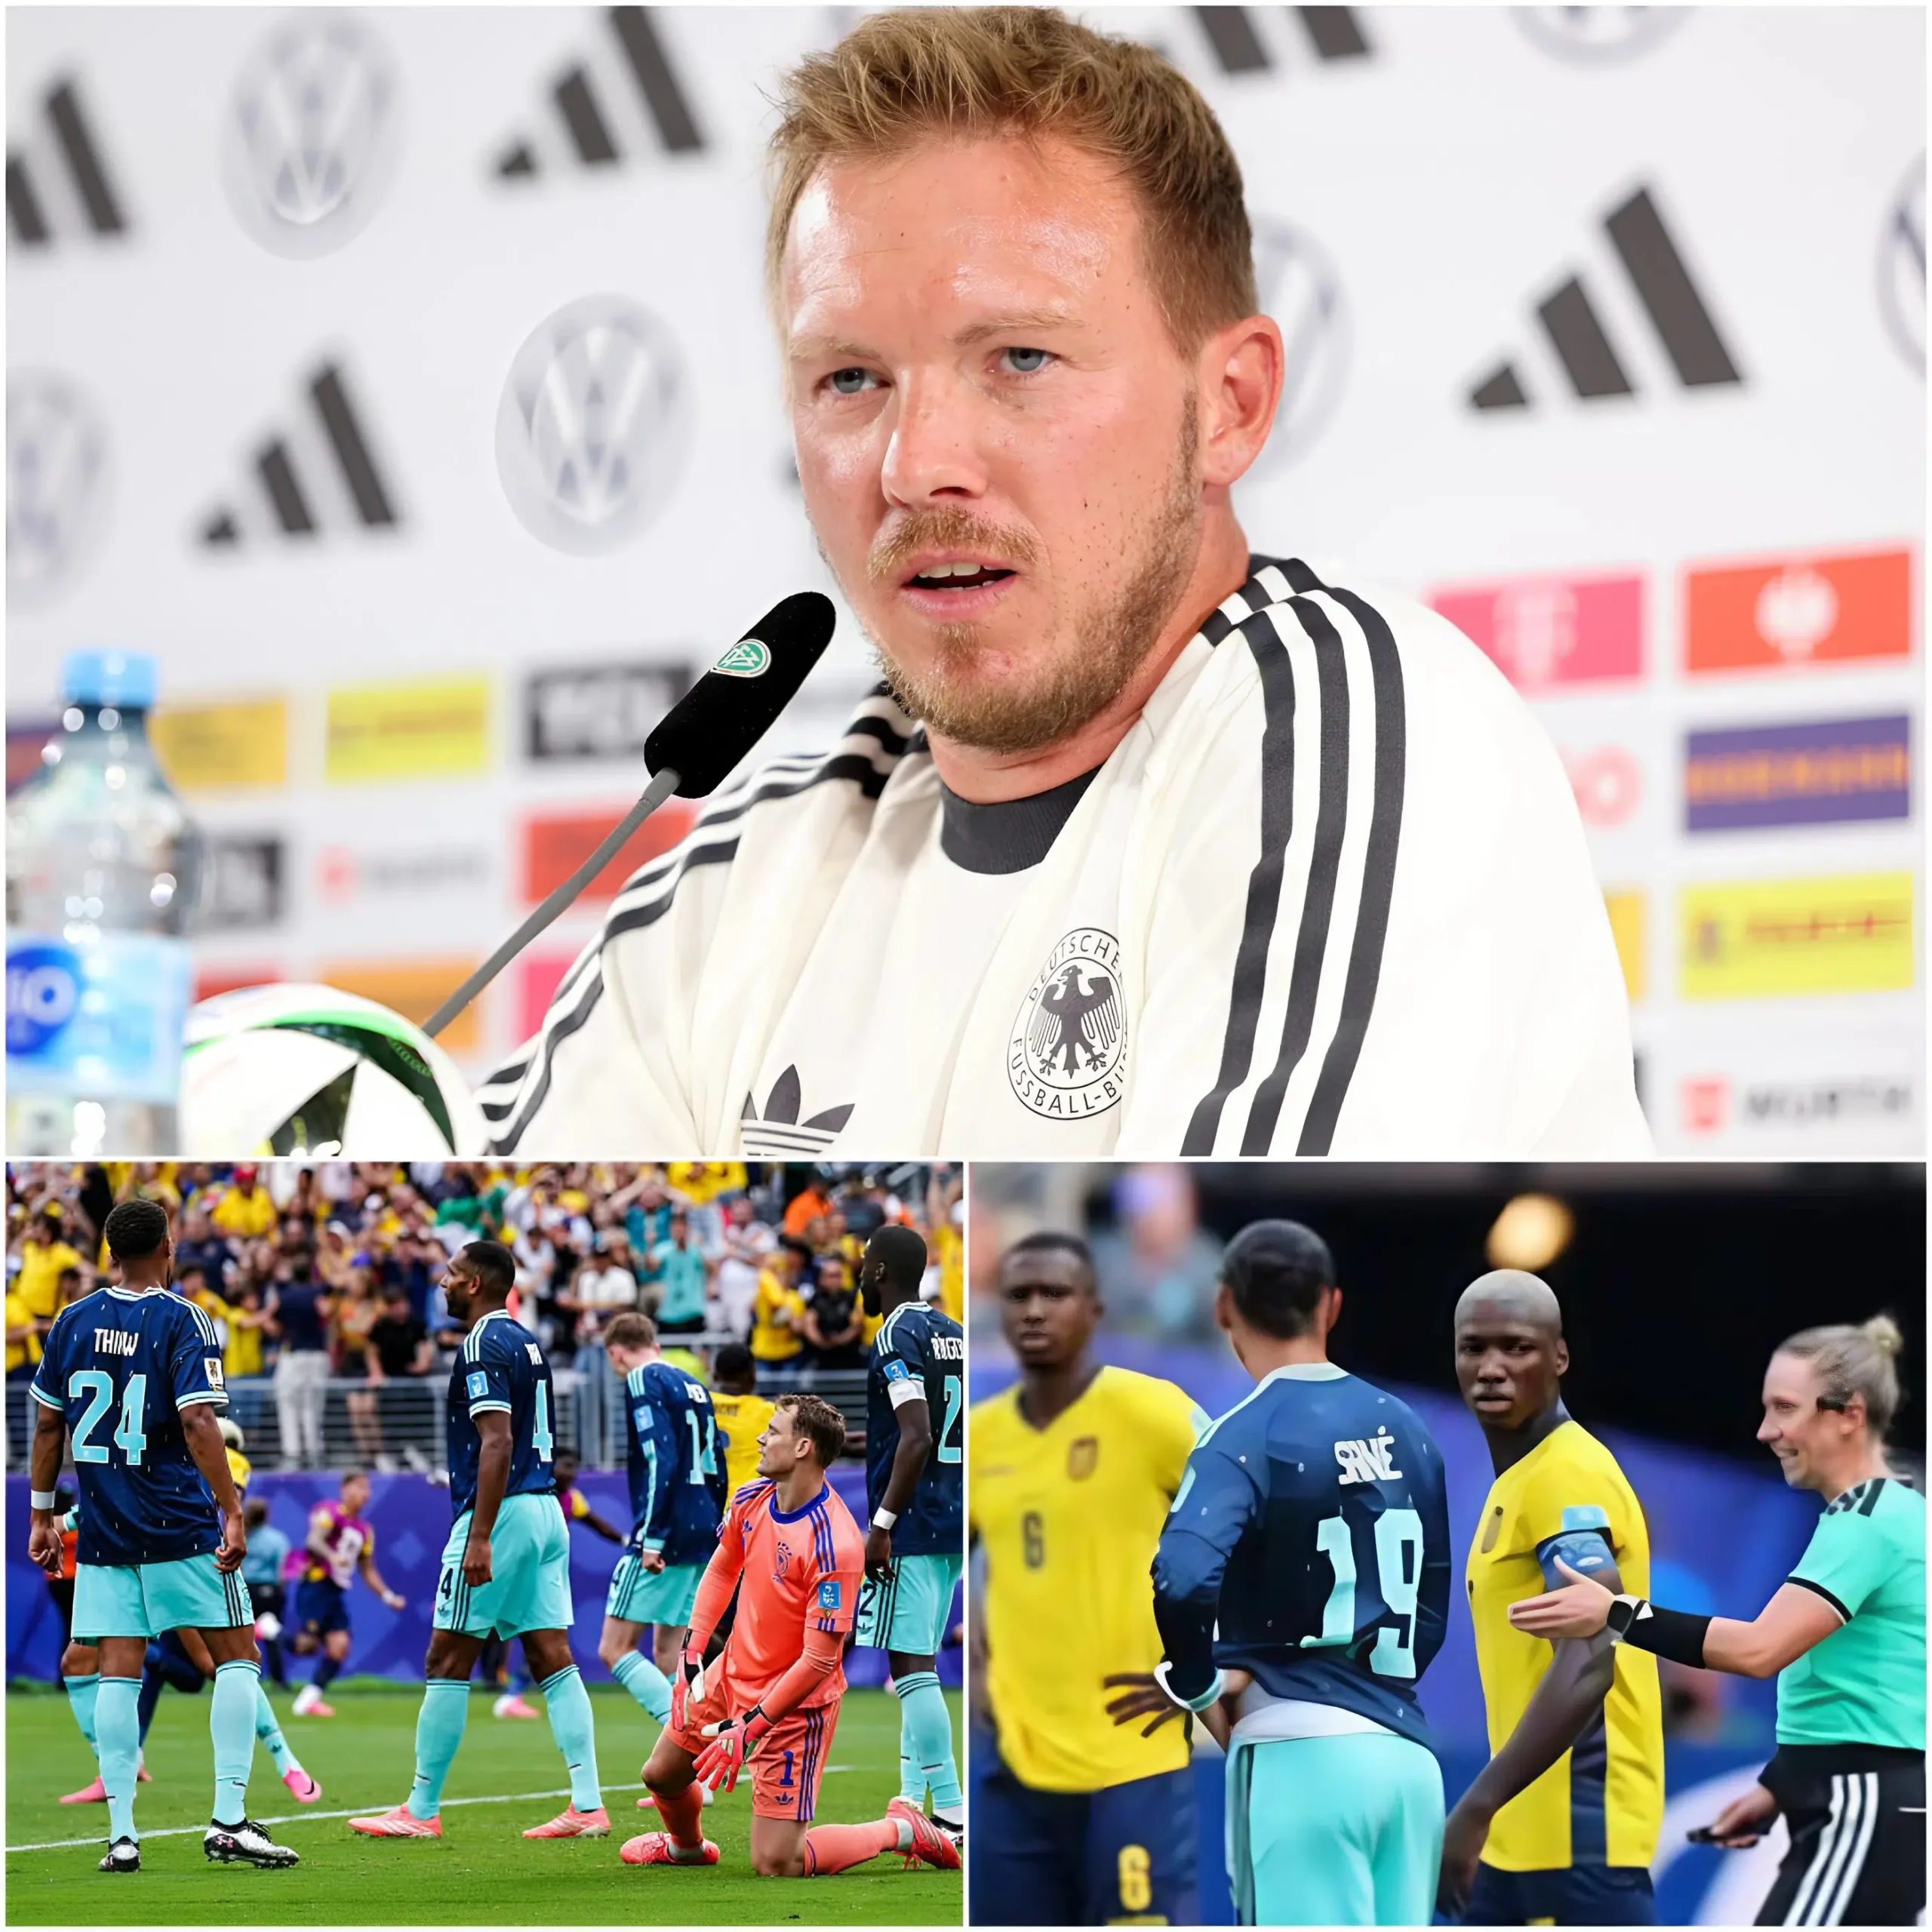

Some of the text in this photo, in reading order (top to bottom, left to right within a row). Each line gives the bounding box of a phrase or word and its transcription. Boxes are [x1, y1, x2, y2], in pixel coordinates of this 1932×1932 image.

[1028, 934, 1123, 1002] DEUTSCHE
[1011, 1031, 1128, 1115] FUSSBALL-B
[69, 1370, 146, 1466] 24
[531, 1379, 554, 1463] 4
[937, 1374, 962, 1463] 2
[1021, 1510, 1044, 1571] 6
[441, 1567, 454, 1601] 4
[859, 1583, 877, 1617] 2
[1300, 1509, 1425, 1678] 19
[779, 1750, 794, 1786] 1
[1118, 1844, 1152, 1911] 6
